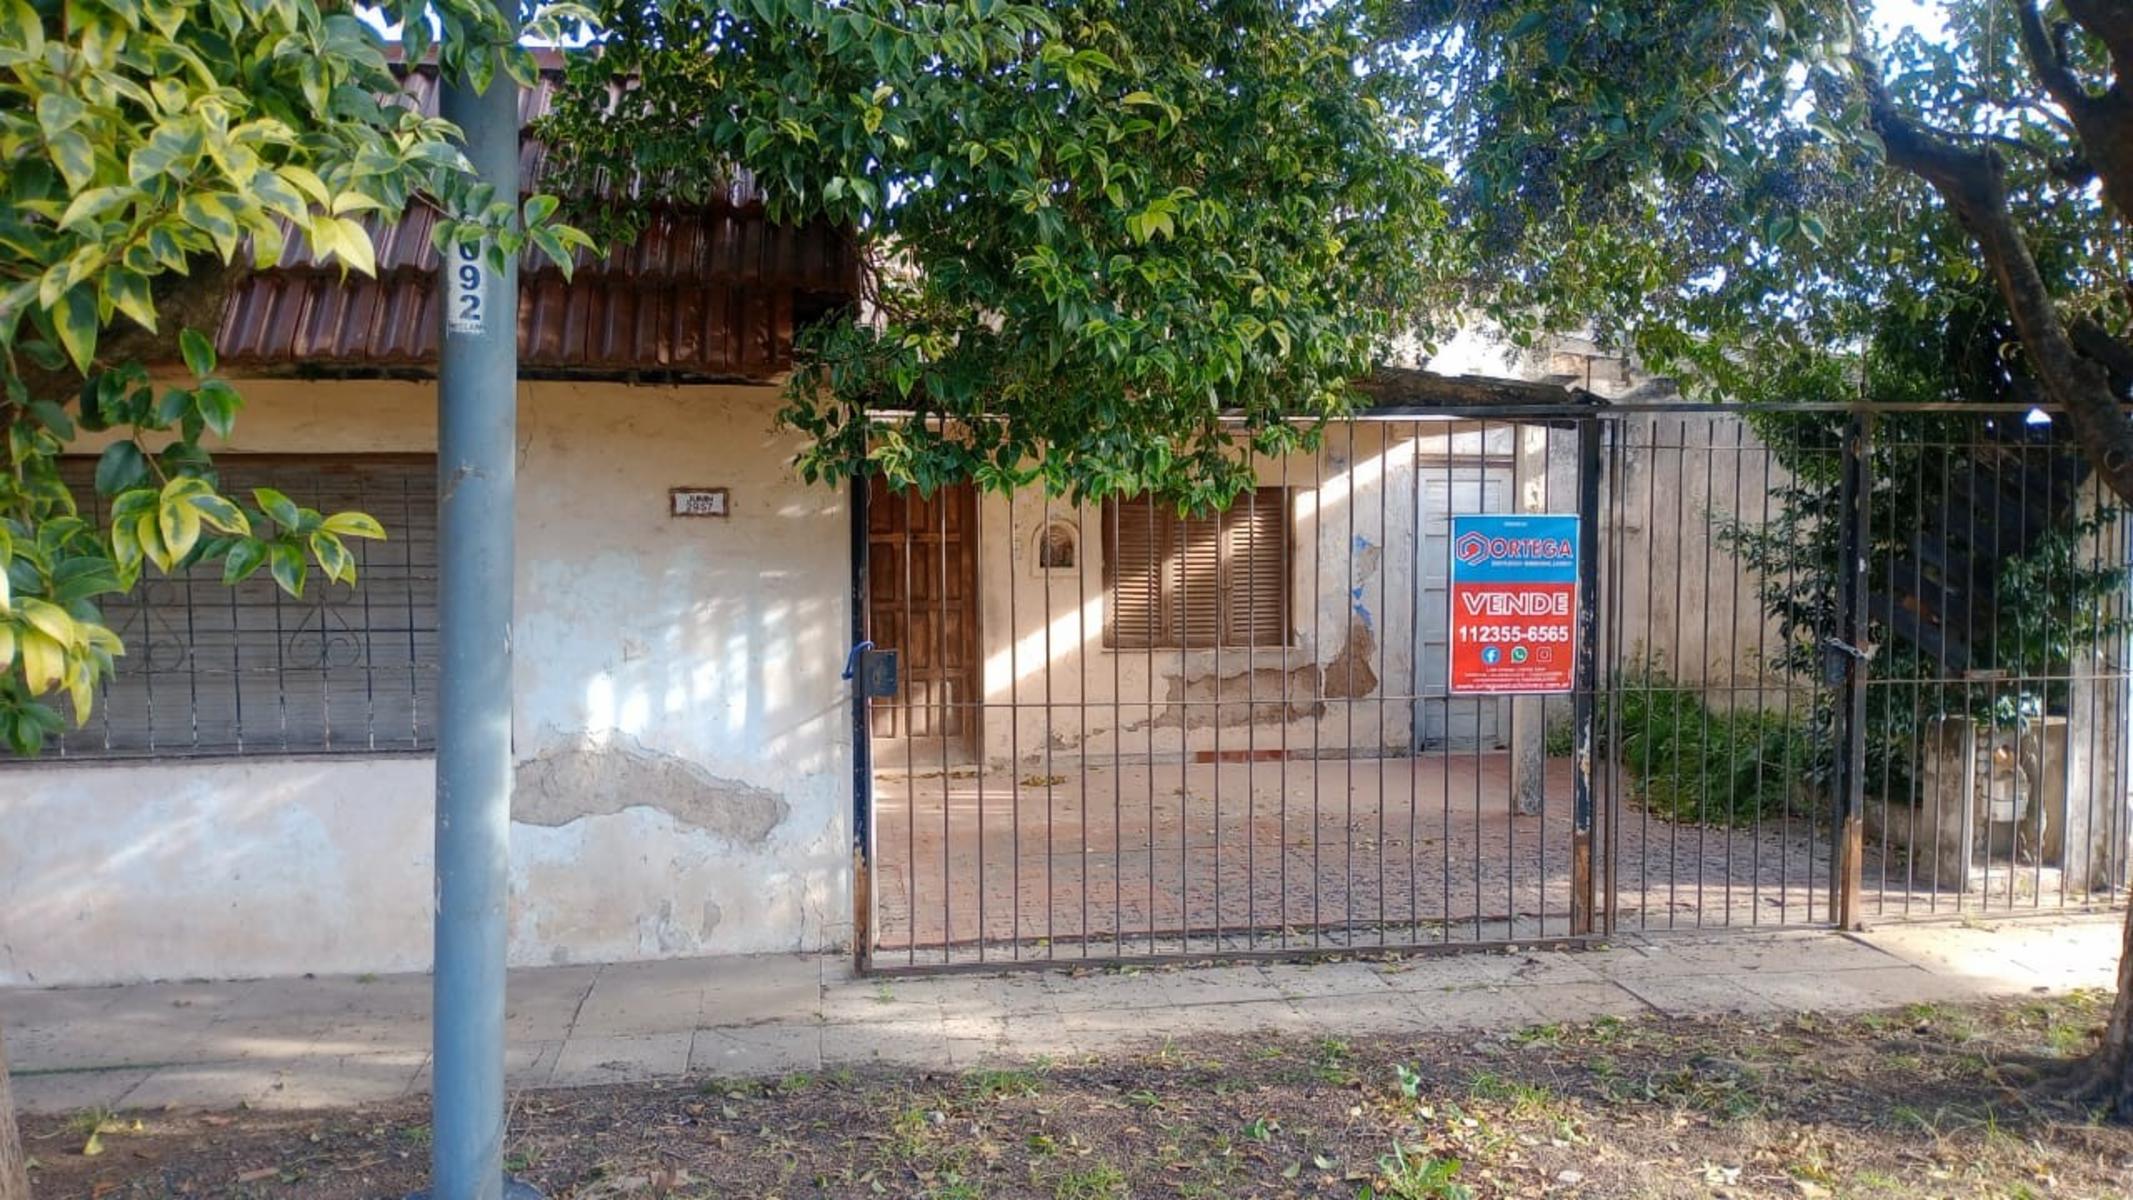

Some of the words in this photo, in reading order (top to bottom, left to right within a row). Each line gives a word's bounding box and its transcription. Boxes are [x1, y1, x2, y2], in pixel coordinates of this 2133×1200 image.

[1490, 537, 1574, 559] ORTEGA
[1462, 592, 1569, 616] VENDE
[1459, 625, 1569, 642] 112355-6565
